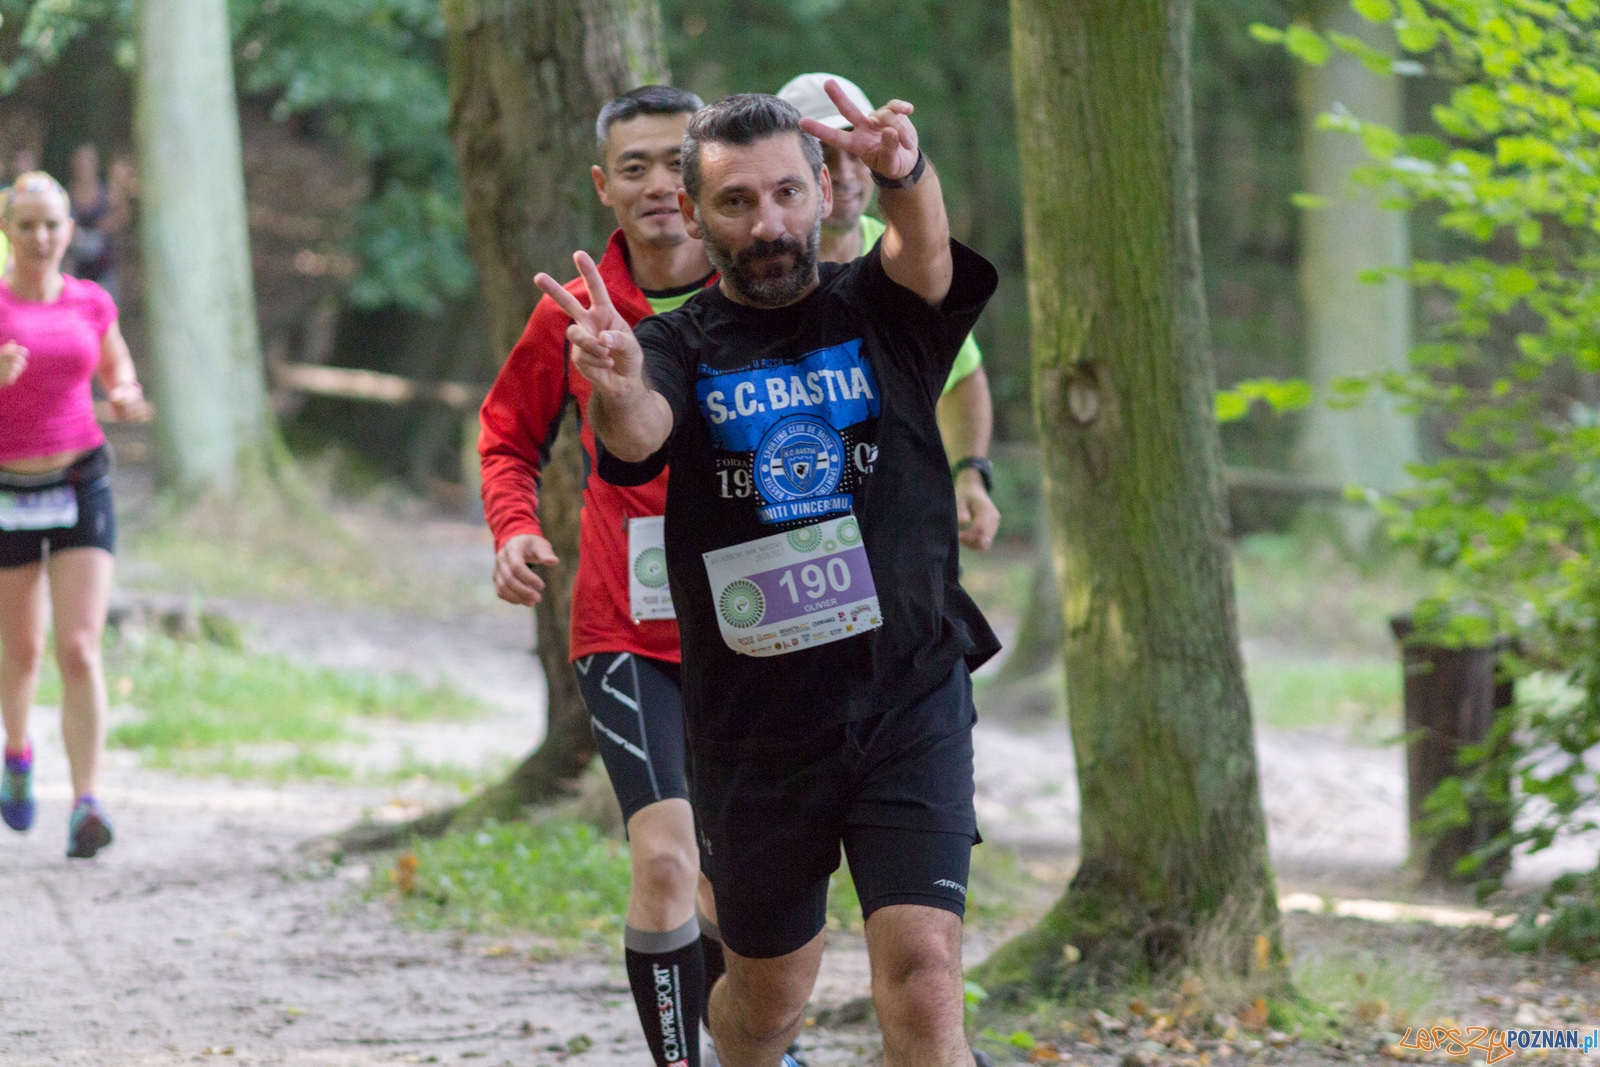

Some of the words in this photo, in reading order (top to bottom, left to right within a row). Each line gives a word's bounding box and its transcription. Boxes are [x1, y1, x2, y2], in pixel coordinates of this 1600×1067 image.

[765, 367, 875, 411] BASTIA
[763, 430, 788, 459] SPORTING
[788, 424, 805, 434] CLUB
[807, 425, 817, 434] DE
[817, 429, 834, 450] BASTIA
[716, 468, 752, 499] 19
[779, 557, 852, 604] 190
[804, 598, 839, 613] OLIVIER
